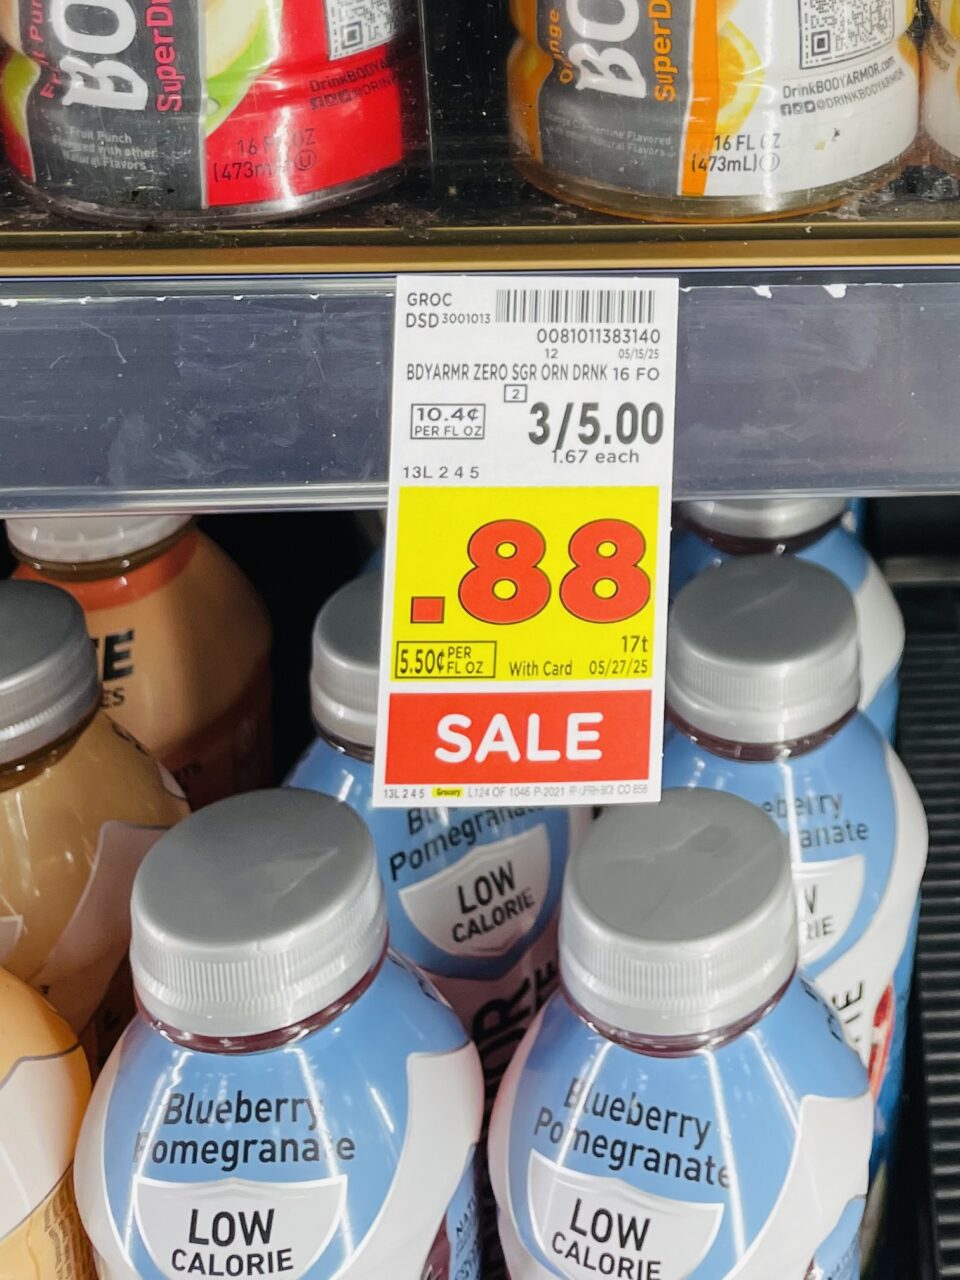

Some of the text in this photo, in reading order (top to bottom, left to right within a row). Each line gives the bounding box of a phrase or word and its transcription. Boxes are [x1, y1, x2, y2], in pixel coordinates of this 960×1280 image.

[238, 138, 257, 155] 16
[714, 134, 755, 151] 16 FL
[692, 154, 758, 173] (473mL)
[407, 293, 453, 307] GROC
[406, 313, 491, 328] DSD 3001013
[537, 328, 661, 344] 0081011383140
[545, 348, 659, 360] 12 05/15/25
[406, 363, 660, 381] BDYARMR ZERO SGR ORN DRNK 16 FO
[414, 425, 483, 437] PER FL OZ
[416, 401, 664, 451] 10.4¢ 3/5.00
[552, 449, 640, 464] 1.67 each
[403, 466, 480, 479] 13L 2 4 5
[410, 518, 651, 625] .88
[621, 635, 649, 654] 17t
[400, 646, 472, 676] 5.50¢ PER
[447, 659, 648, 677] FL OZ With Card 05/27/25
[434, 712, 604, 764] SALE
[384, 787, 461, 800] 13L Grocery
[390, 807, 544, 881] Pomegranat
[457, 860, 516, 914] LOW
[452, 888, 535, 943] CALORIE
[163, 1090, 323, 1131] Blueberry
[563, 1078, 712, 1150] Blueberry
[533, 1106, 731, 1189] Pomegranate
[188, 1208, 275, 1247] LOW
[570, 1198, 652, 1252] LOW
[171, 1248, 294, 1277] CALORIE
[551, 1231, 662, 1280] CALORIE
